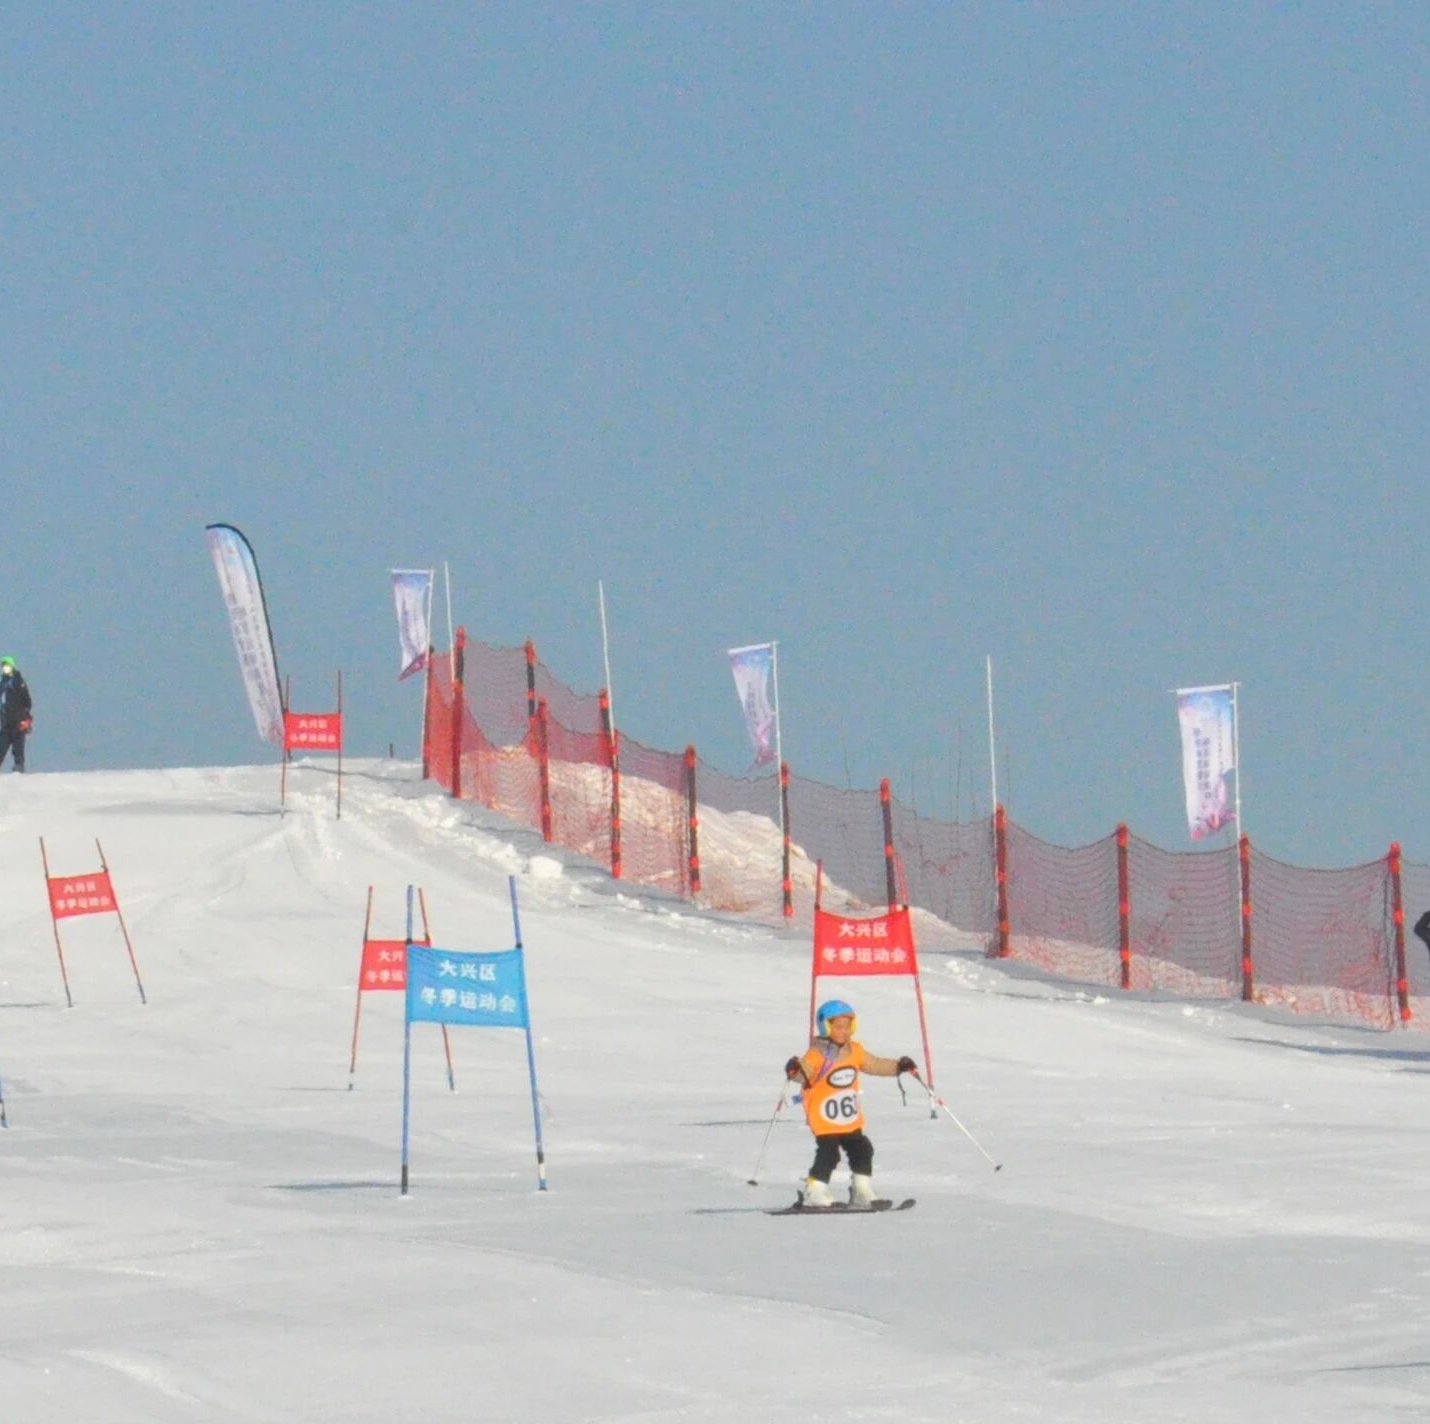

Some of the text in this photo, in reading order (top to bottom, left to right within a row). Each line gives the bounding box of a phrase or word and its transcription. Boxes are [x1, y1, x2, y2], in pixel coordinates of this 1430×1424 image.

[838, 922, 888, 937] 大兴区
[378, 949, 404, 962] 大兴
[822, 946, 907, 964] 冬季运动会
[365, 969, 405, 983] 冬季运
[438, 959, 497, 981] 大兴区
[420, 986, 517, 1013] 冬季运动会
[825, 1094, 858, 1120] 06
